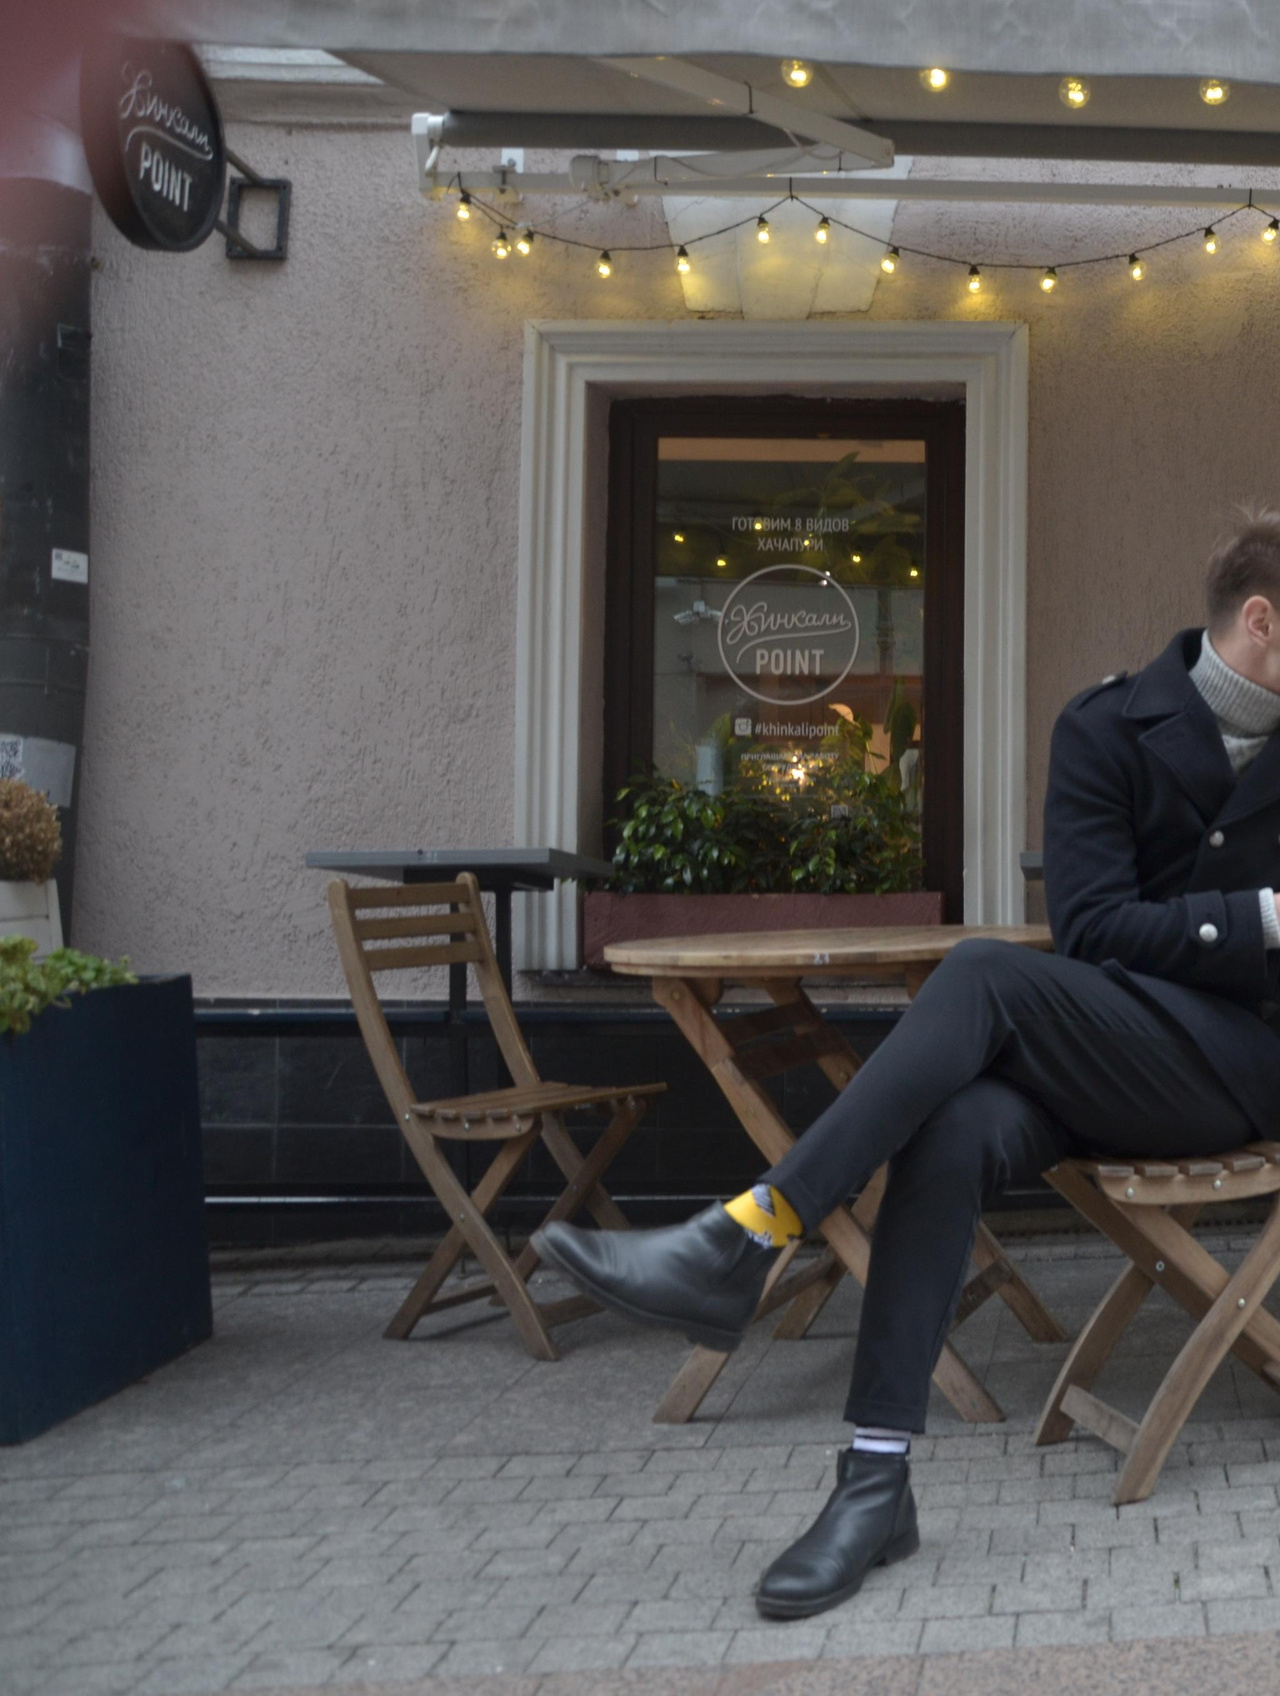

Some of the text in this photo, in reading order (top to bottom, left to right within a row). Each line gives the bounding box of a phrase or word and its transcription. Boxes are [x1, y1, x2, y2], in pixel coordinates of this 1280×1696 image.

[139, 139, 192, 212] POINT
[795, 517, 802, 532] 8
[806, 517, 850, 534] ВИДОВ
[757, 536, 824, 553] ХАЧАПУРИ
[725, 601, 851, 650] Хинкали
[755, 648, 826, 676] POINT
[755, 721, 840, 740] #khinkalipoint
